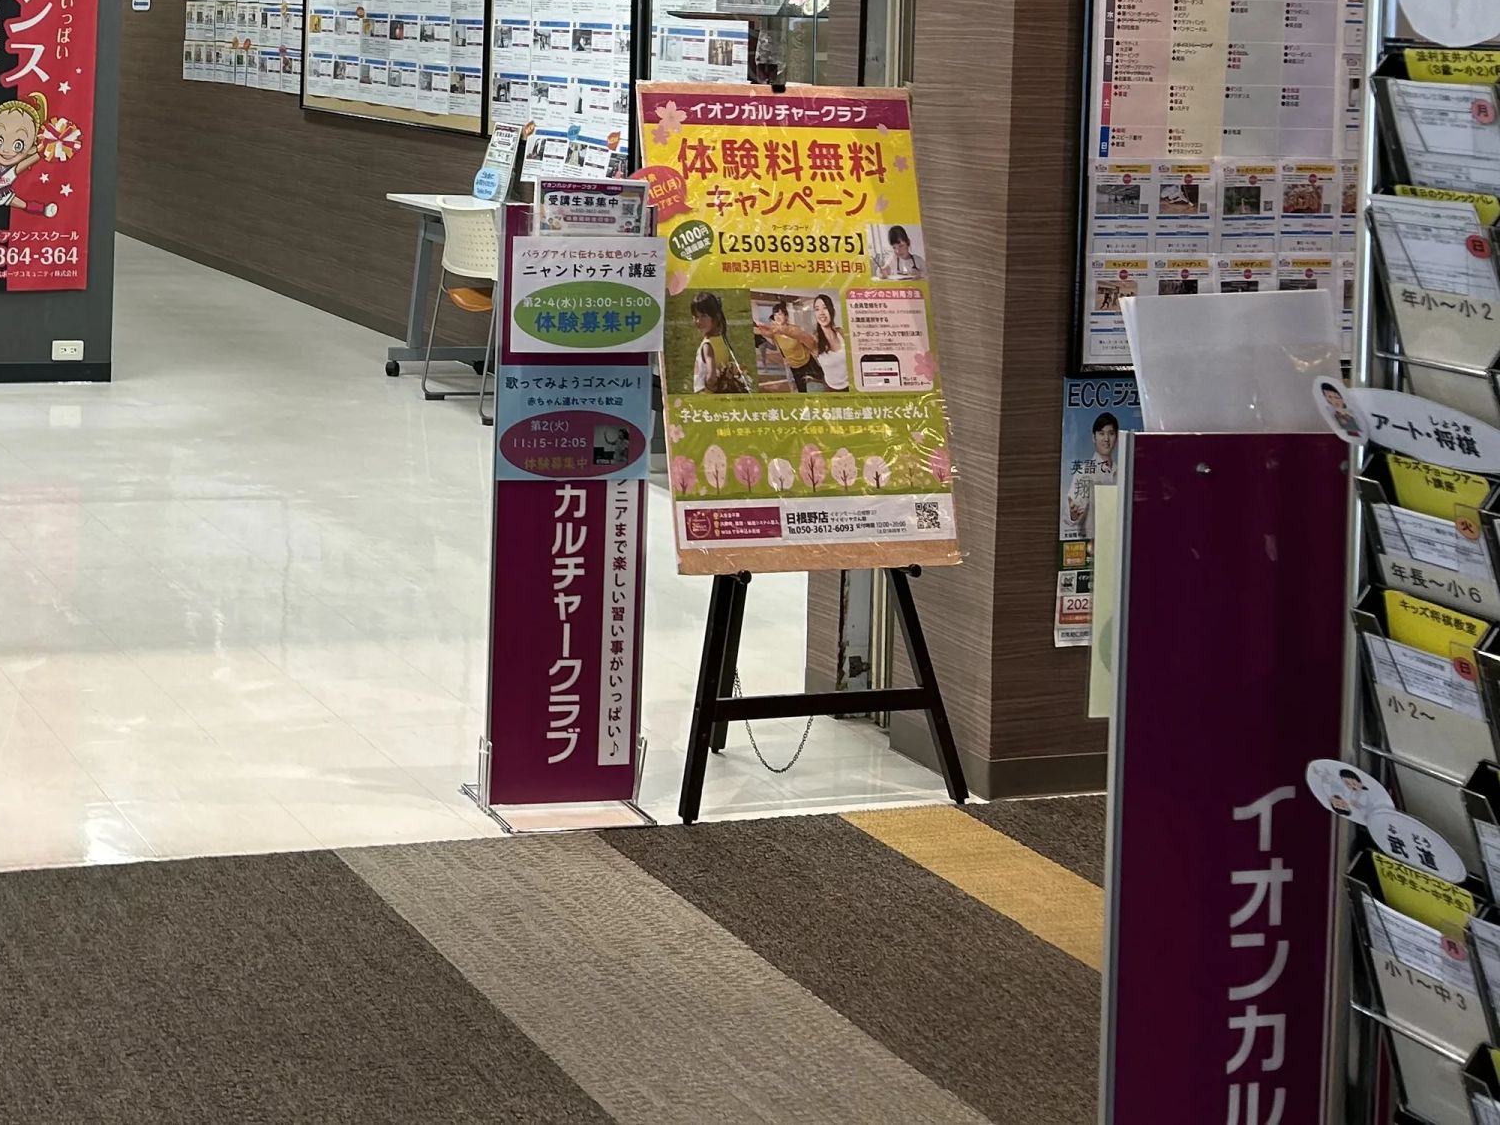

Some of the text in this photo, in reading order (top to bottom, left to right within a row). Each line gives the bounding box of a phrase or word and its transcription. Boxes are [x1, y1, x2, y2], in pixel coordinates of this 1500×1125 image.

[690, 101, 868, 123] イオンカルチャークラブ
[678, 136, 887, 184] 体験料無料
[548, 194, 619, 208] 受講生募集中
[705, 184, 868, 217] キャンペーン
[522, 263, 657, 278] ニャンドゥティ講座
[849, 290, 922, 299] クーポンのご利用方法
[534, 311, 642, 333] 体験募集中
[527, 396, 624, 407] 赤ちゃん連れママも歓迎
[1067, 381, 1142, 408] ECCジュ
[513, 437, 587, 449] 11:15-12:05
[1371, 413, 1481, 458] アート・将棋
[786, 512, 829, 524] 日根野店
[546, 483, 587, 764] カルチャークラブ
[1399, 598, 1478, 637] キッズ将棋教室
[1387, 835, 1439, 872] 武道
[1226, 785, 1296, 1125] イオンカル
